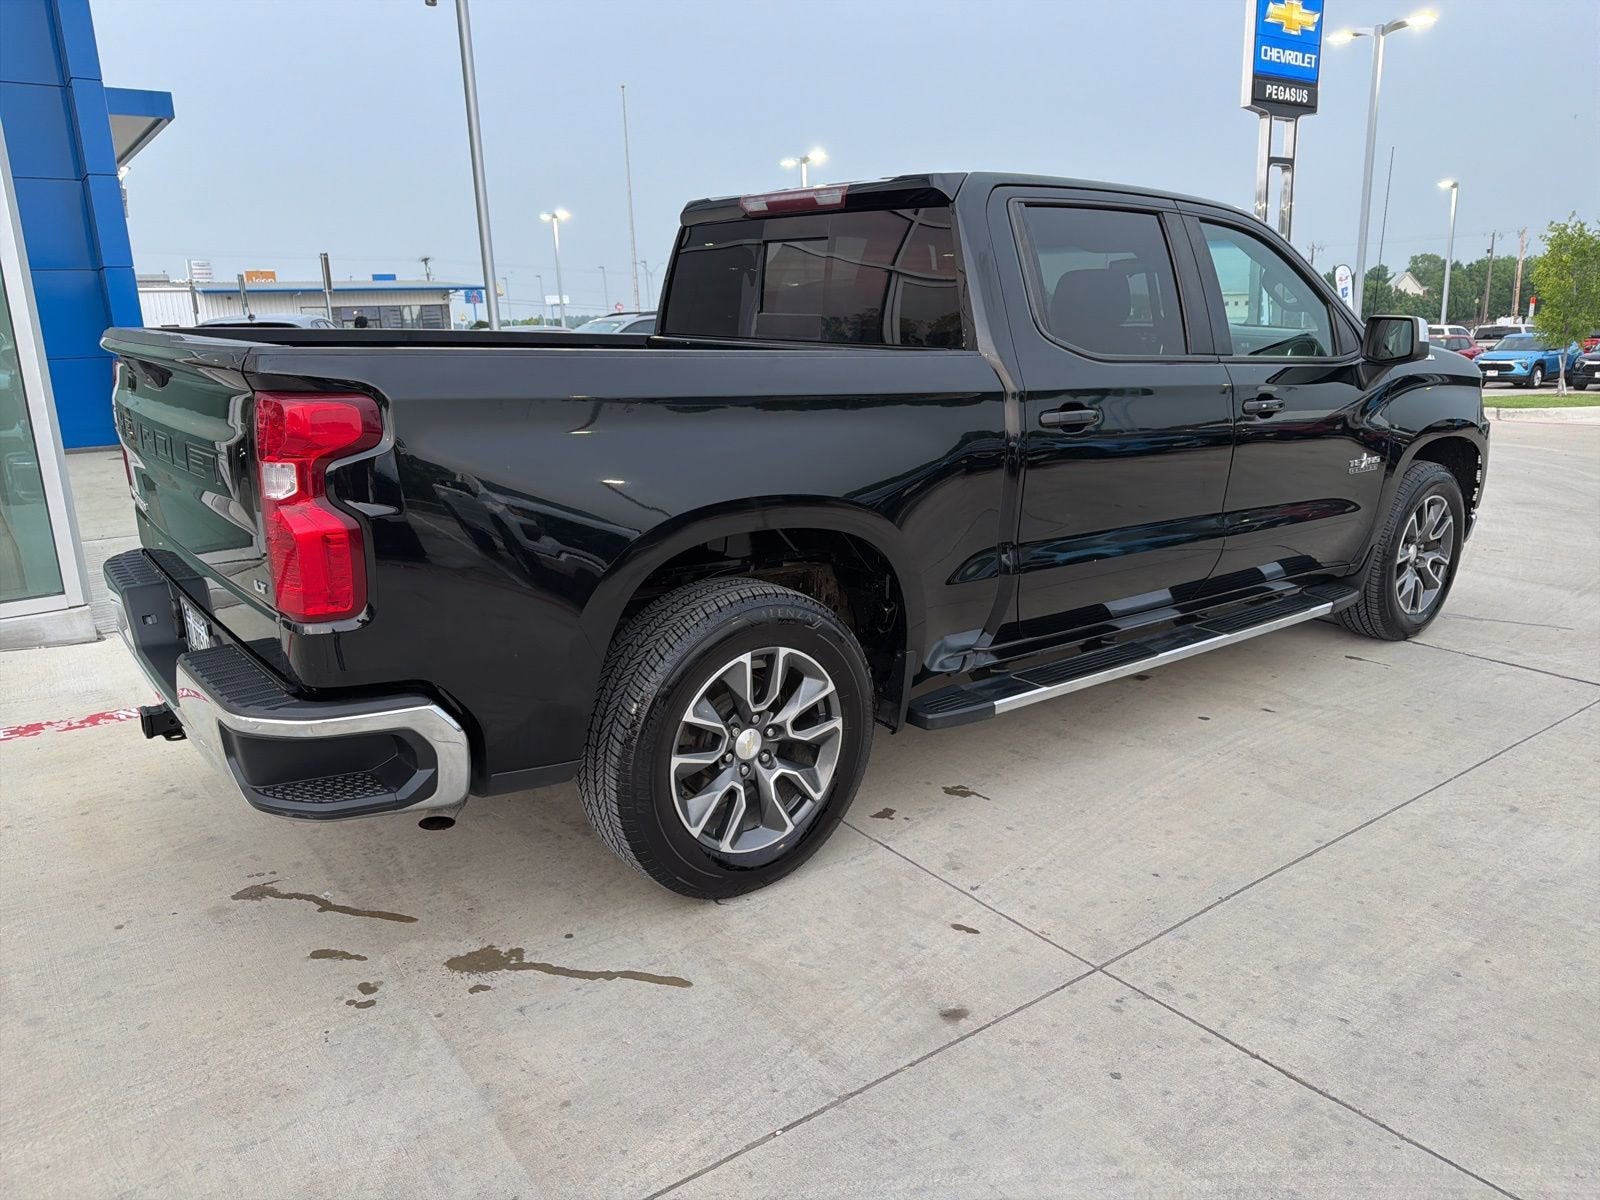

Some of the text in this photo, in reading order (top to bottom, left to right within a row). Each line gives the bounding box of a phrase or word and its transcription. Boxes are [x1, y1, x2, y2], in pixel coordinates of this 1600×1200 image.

[1261, 45, 1317, 69] CHEVROLET
[1265, 84, 1309, 104] PEGASUS
[253, 579, 268, 595] LT
